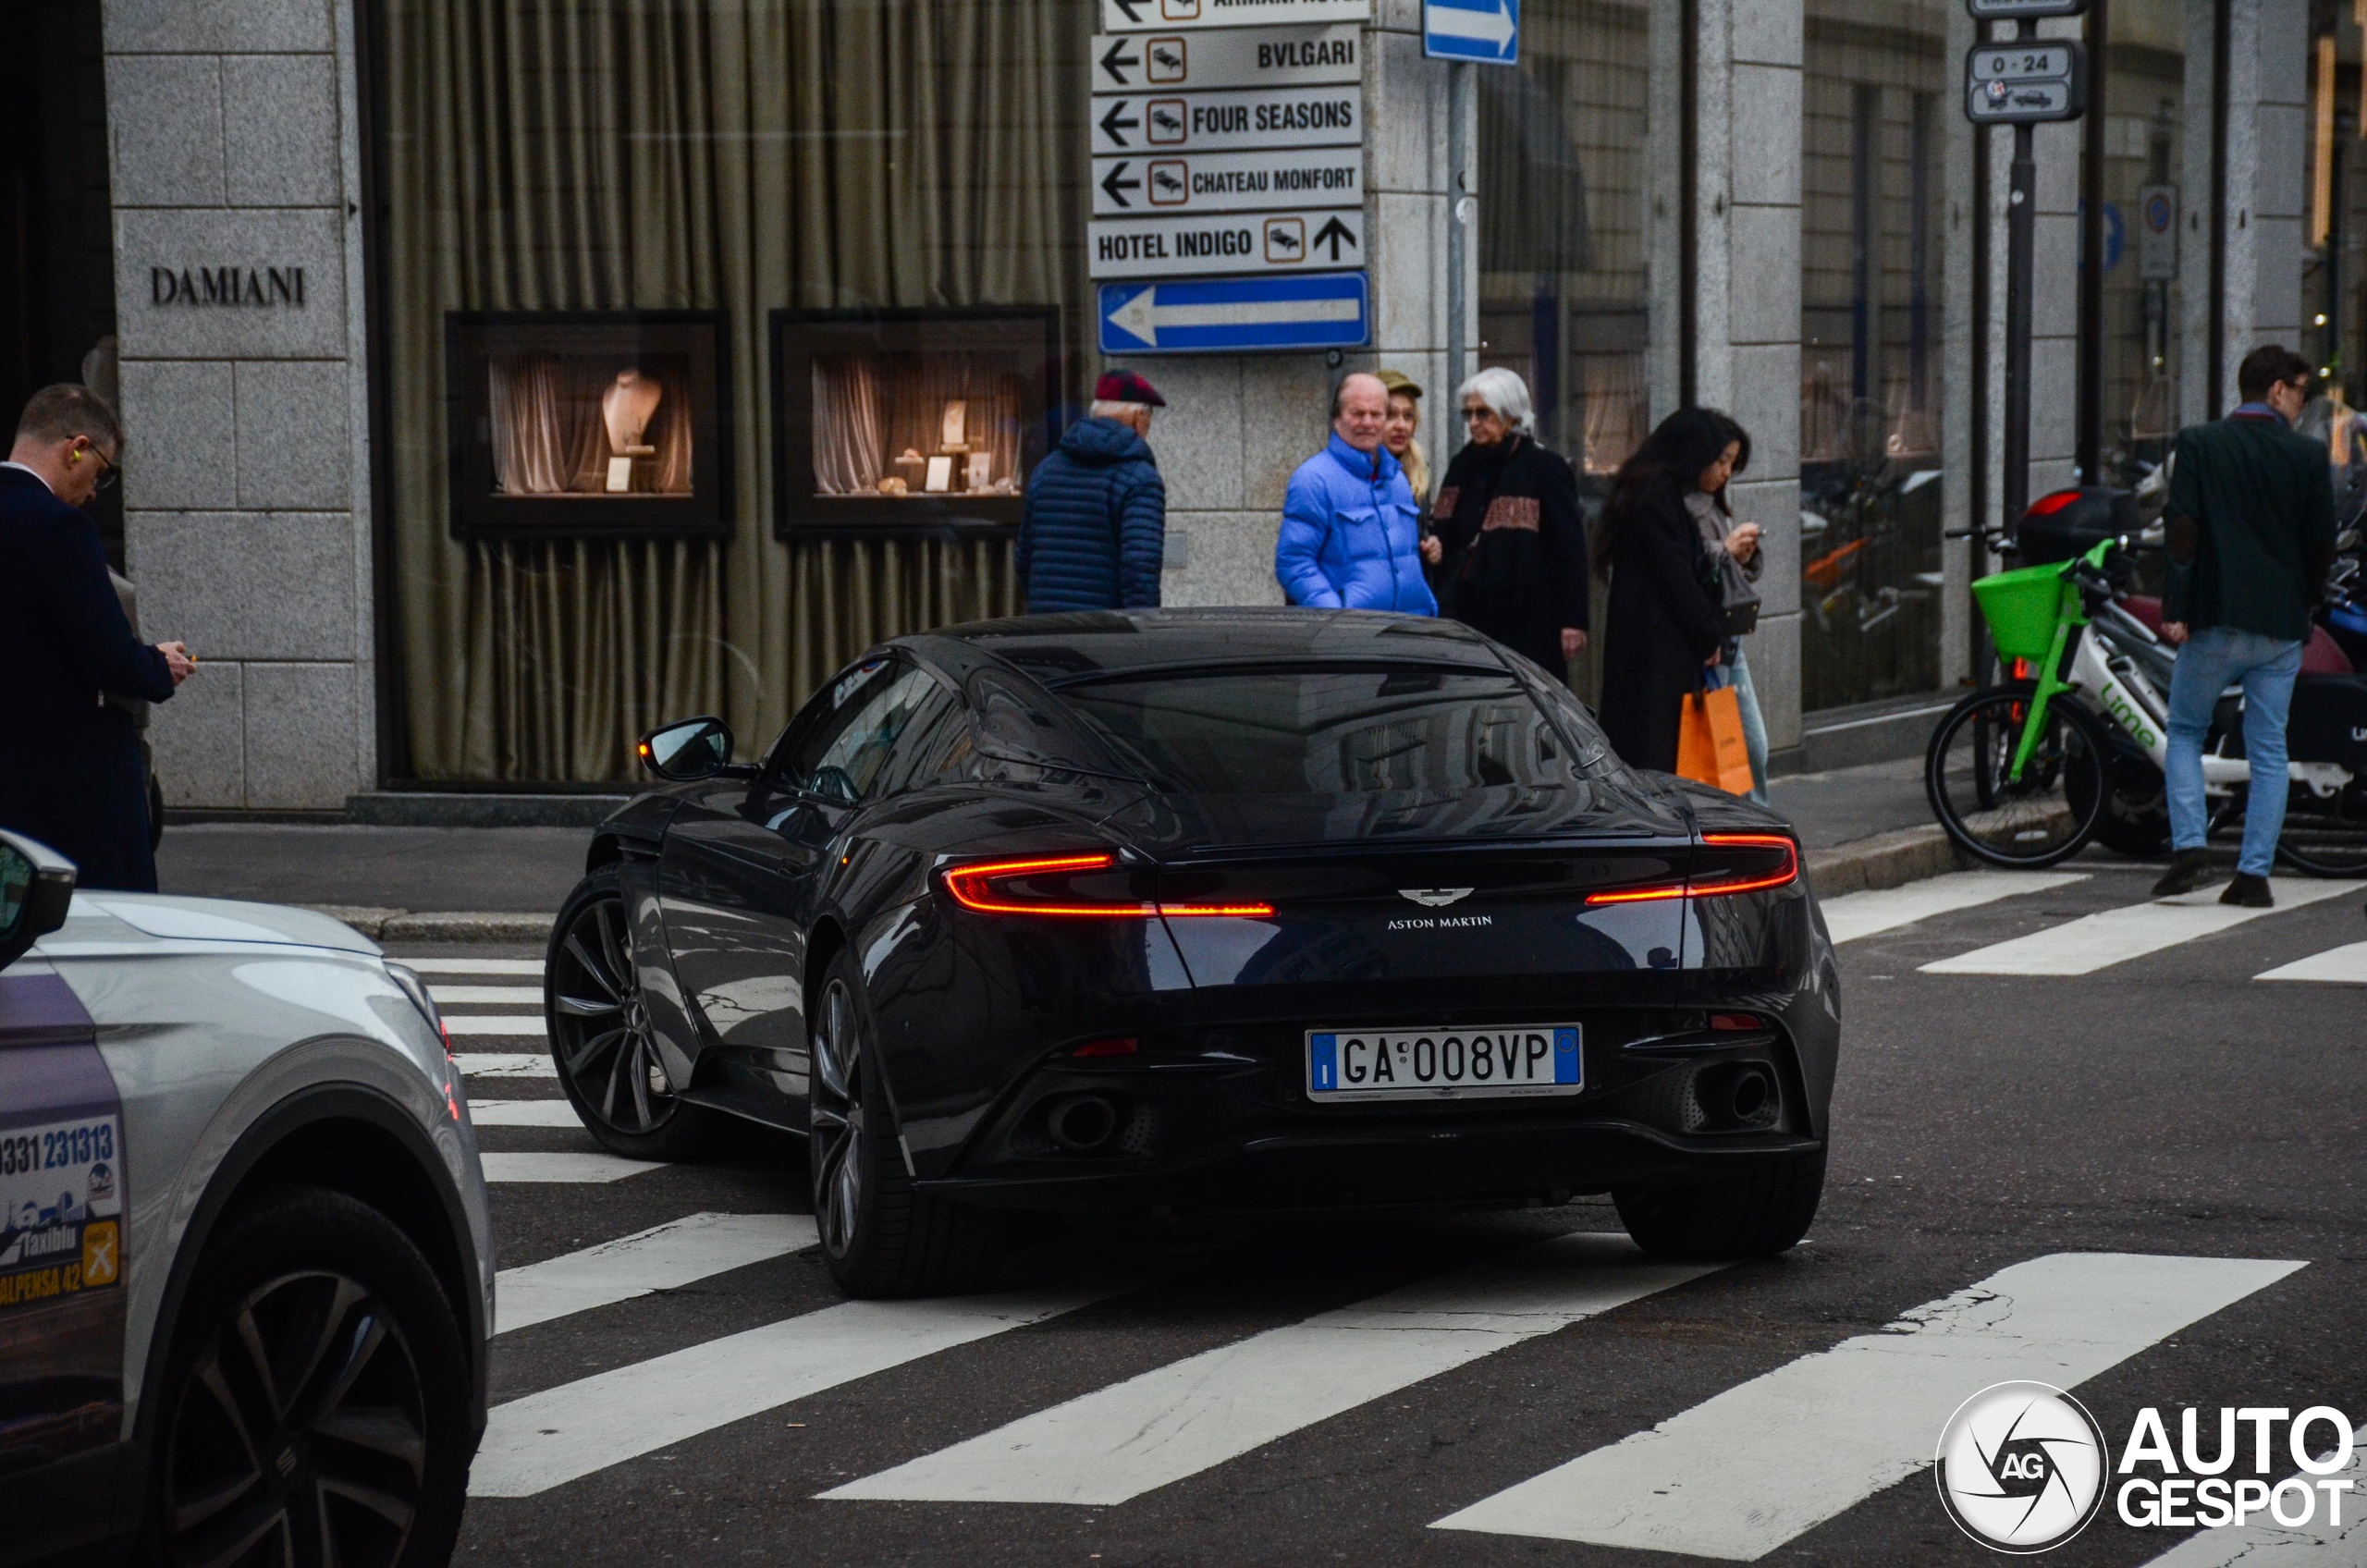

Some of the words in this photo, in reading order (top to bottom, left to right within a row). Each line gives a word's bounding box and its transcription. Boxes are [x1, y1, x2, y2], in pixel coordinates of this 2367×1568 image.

[1258, 42, 1354, 68] BVLGARI
[1993, 56, 2005, 74] 0
[2023, 55, 2048, 73] 24
[1193, 105, 1248, 133] FOUR
[1255, 101, 1353, 131] SEASONS
[1193, 173, 1269, 194] CHATEAU
[1273, 167, 1355, 190] MONFORT
[1098, 234, 1169, 261] HOTEL
[1176, 229, 1252, 257] INDIGO
[151, 265, 306, 307] DAMIANI
[2101, 681, 2156, 747] Lime
[1388, 919, 1434, 930] ASTON
[1440, 915, 1492, 927] MARTIN
[0, 1135, 40, 1175] 331
[44, 1124, 113, 1169] 231313
[63, 1264, 80, 1292] 42
